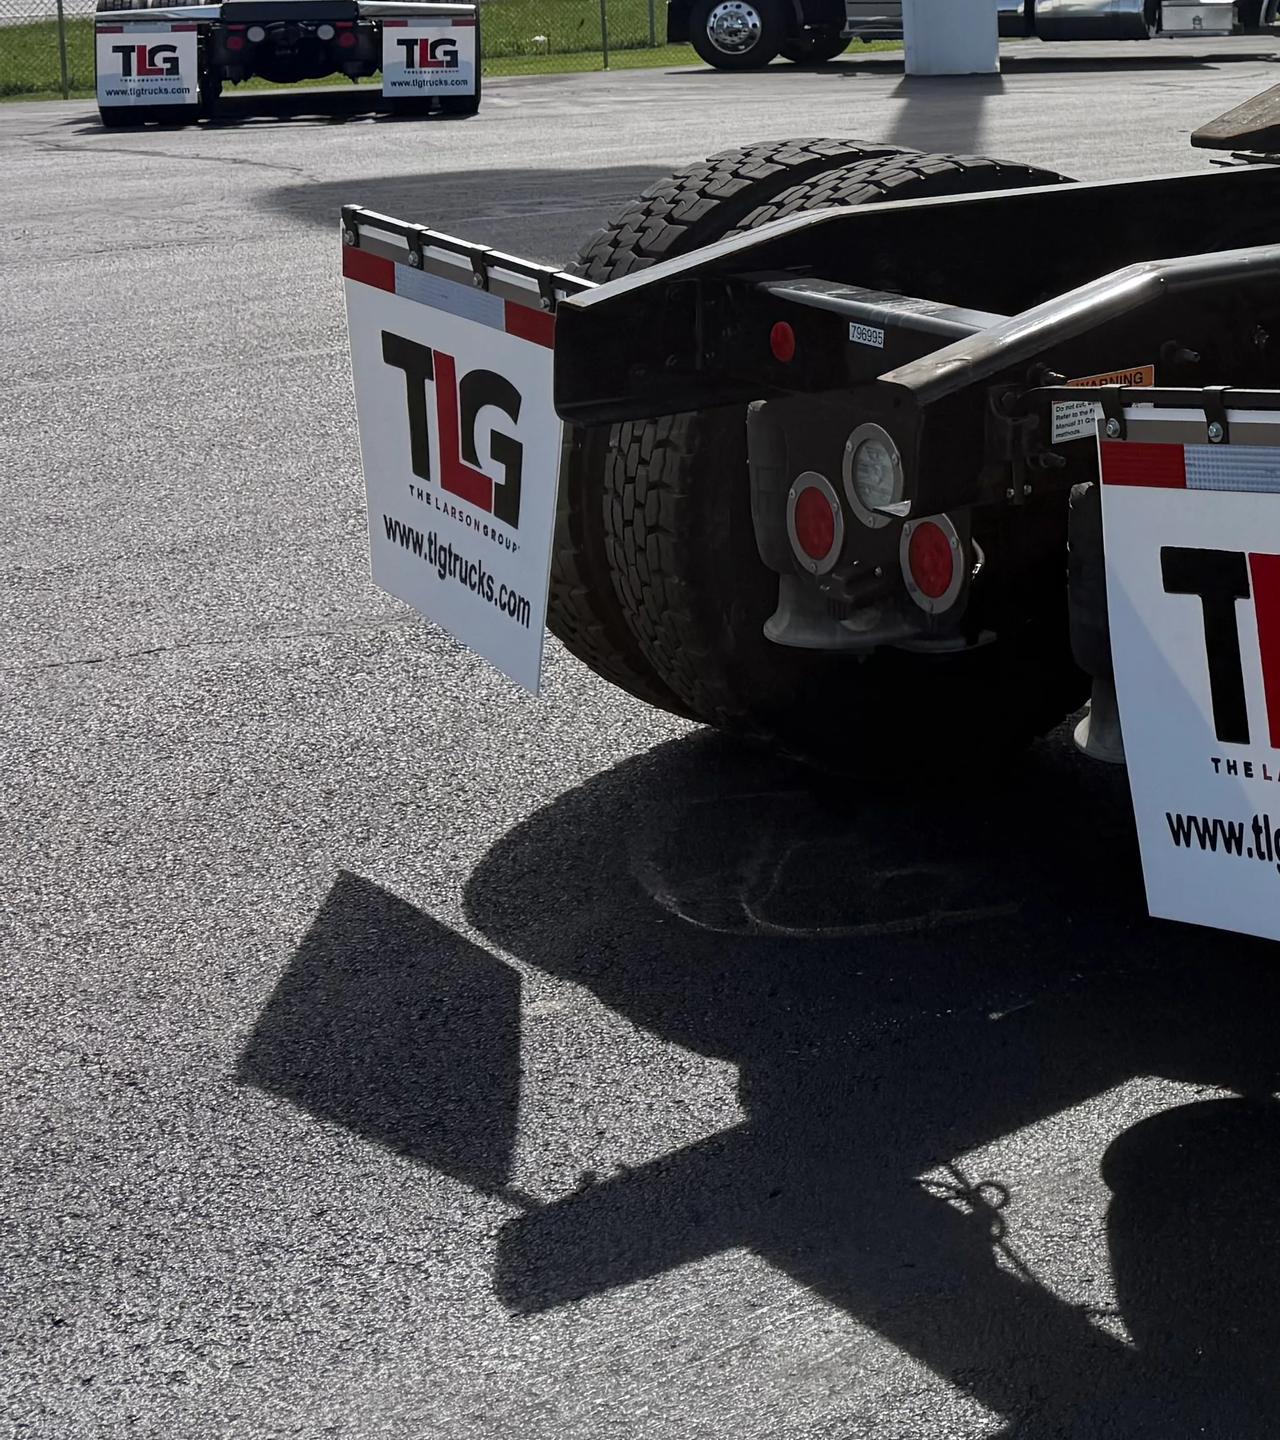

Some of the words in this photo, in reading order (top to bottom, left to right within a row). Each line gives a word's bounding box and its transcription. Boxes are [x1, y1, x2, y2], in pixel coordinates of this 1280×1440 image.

[111, 44, 180, 77] TLG
[396, 38, 459, 69] TLG
[105, 86, 190, 97] www.tlgtrucks.com
[390, 78, 468, 88] www.tlgtrucks.com
[851, 324, 883, 345] 796995
[381, 329, 523, 530] TLG
[408, 483, 432, 506] THE
[435, 496, 481, 534] LARSON
[482, 523, 518, 554] GROUP
[383, 513, 531, 629] www.tlgtrucks.com
[1211, 757, 1254, 779] THE
